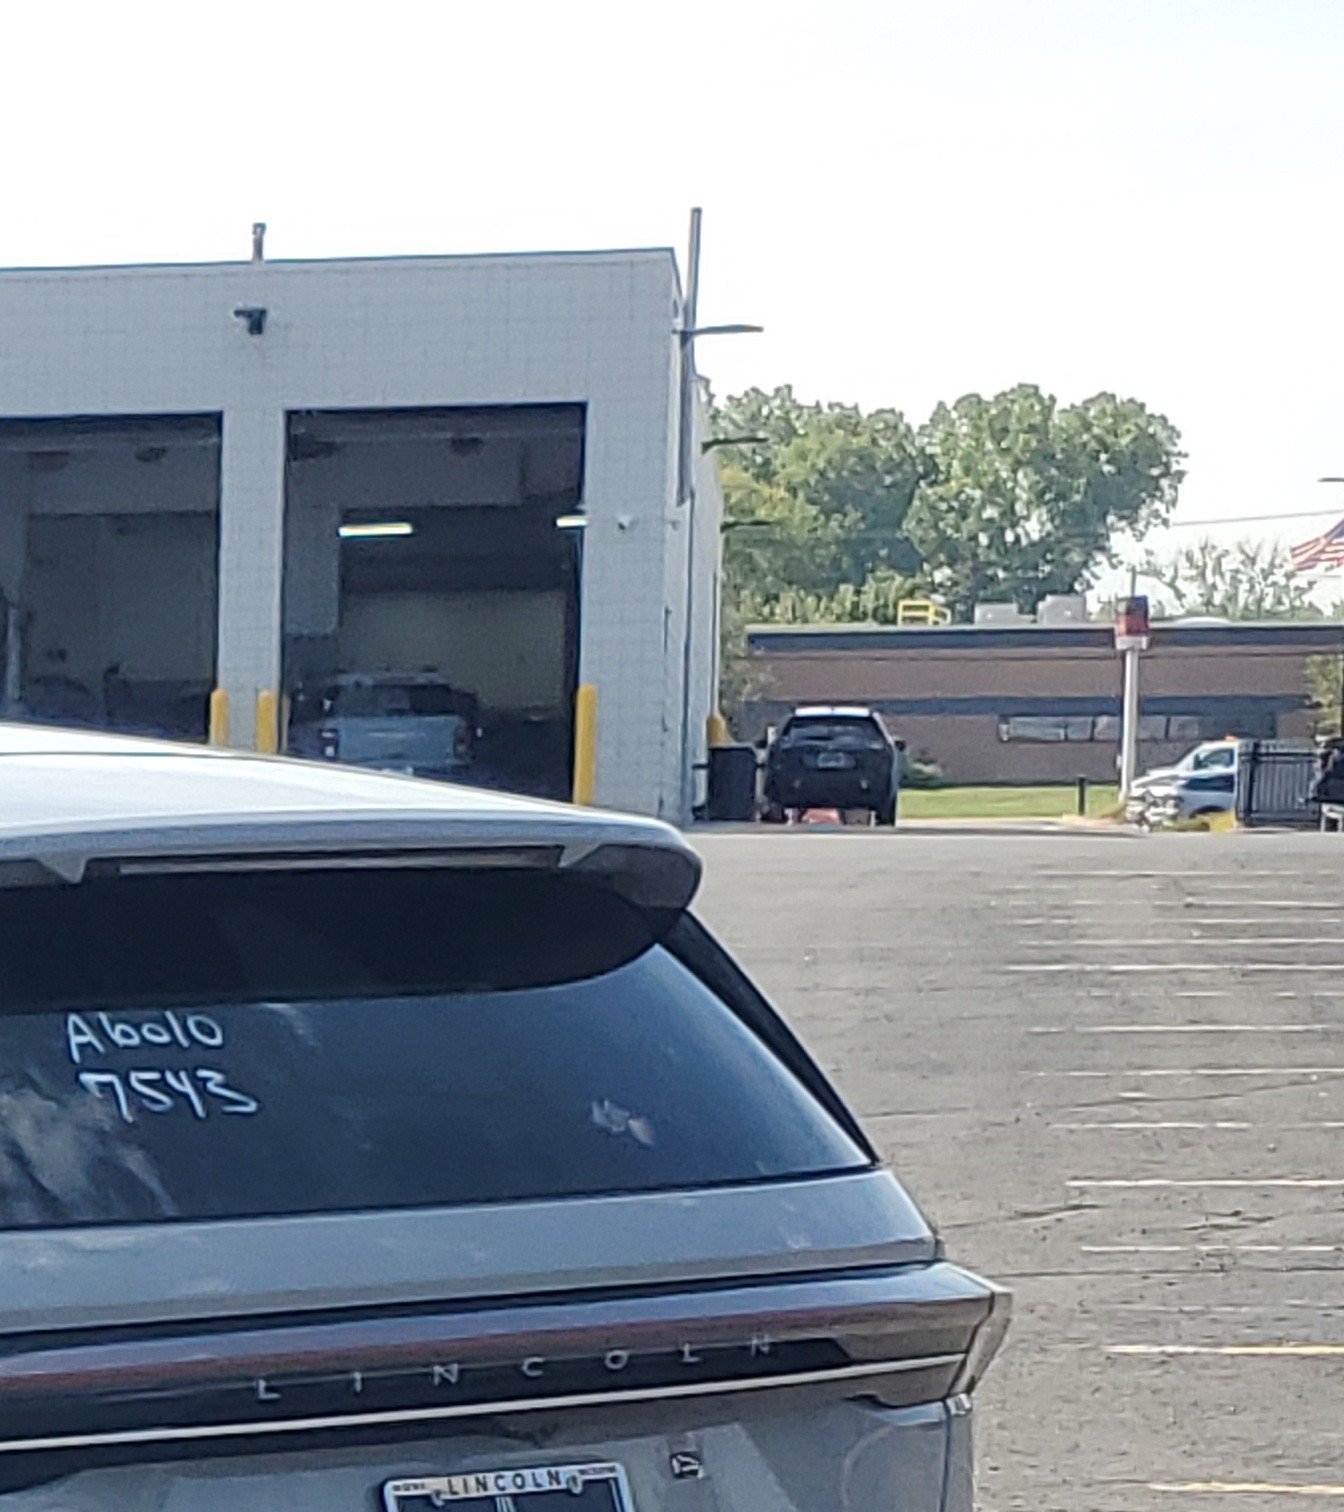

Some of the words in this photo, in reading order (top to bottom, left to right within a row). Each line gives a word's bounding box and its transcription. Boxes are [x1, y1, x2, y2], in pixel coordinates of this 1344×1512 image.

[77, 1068, 258, 1123] 7543
[254, 1333, 772, 1400] LINCOLN
[447, 1469, 562, 1497] LINCOLN
